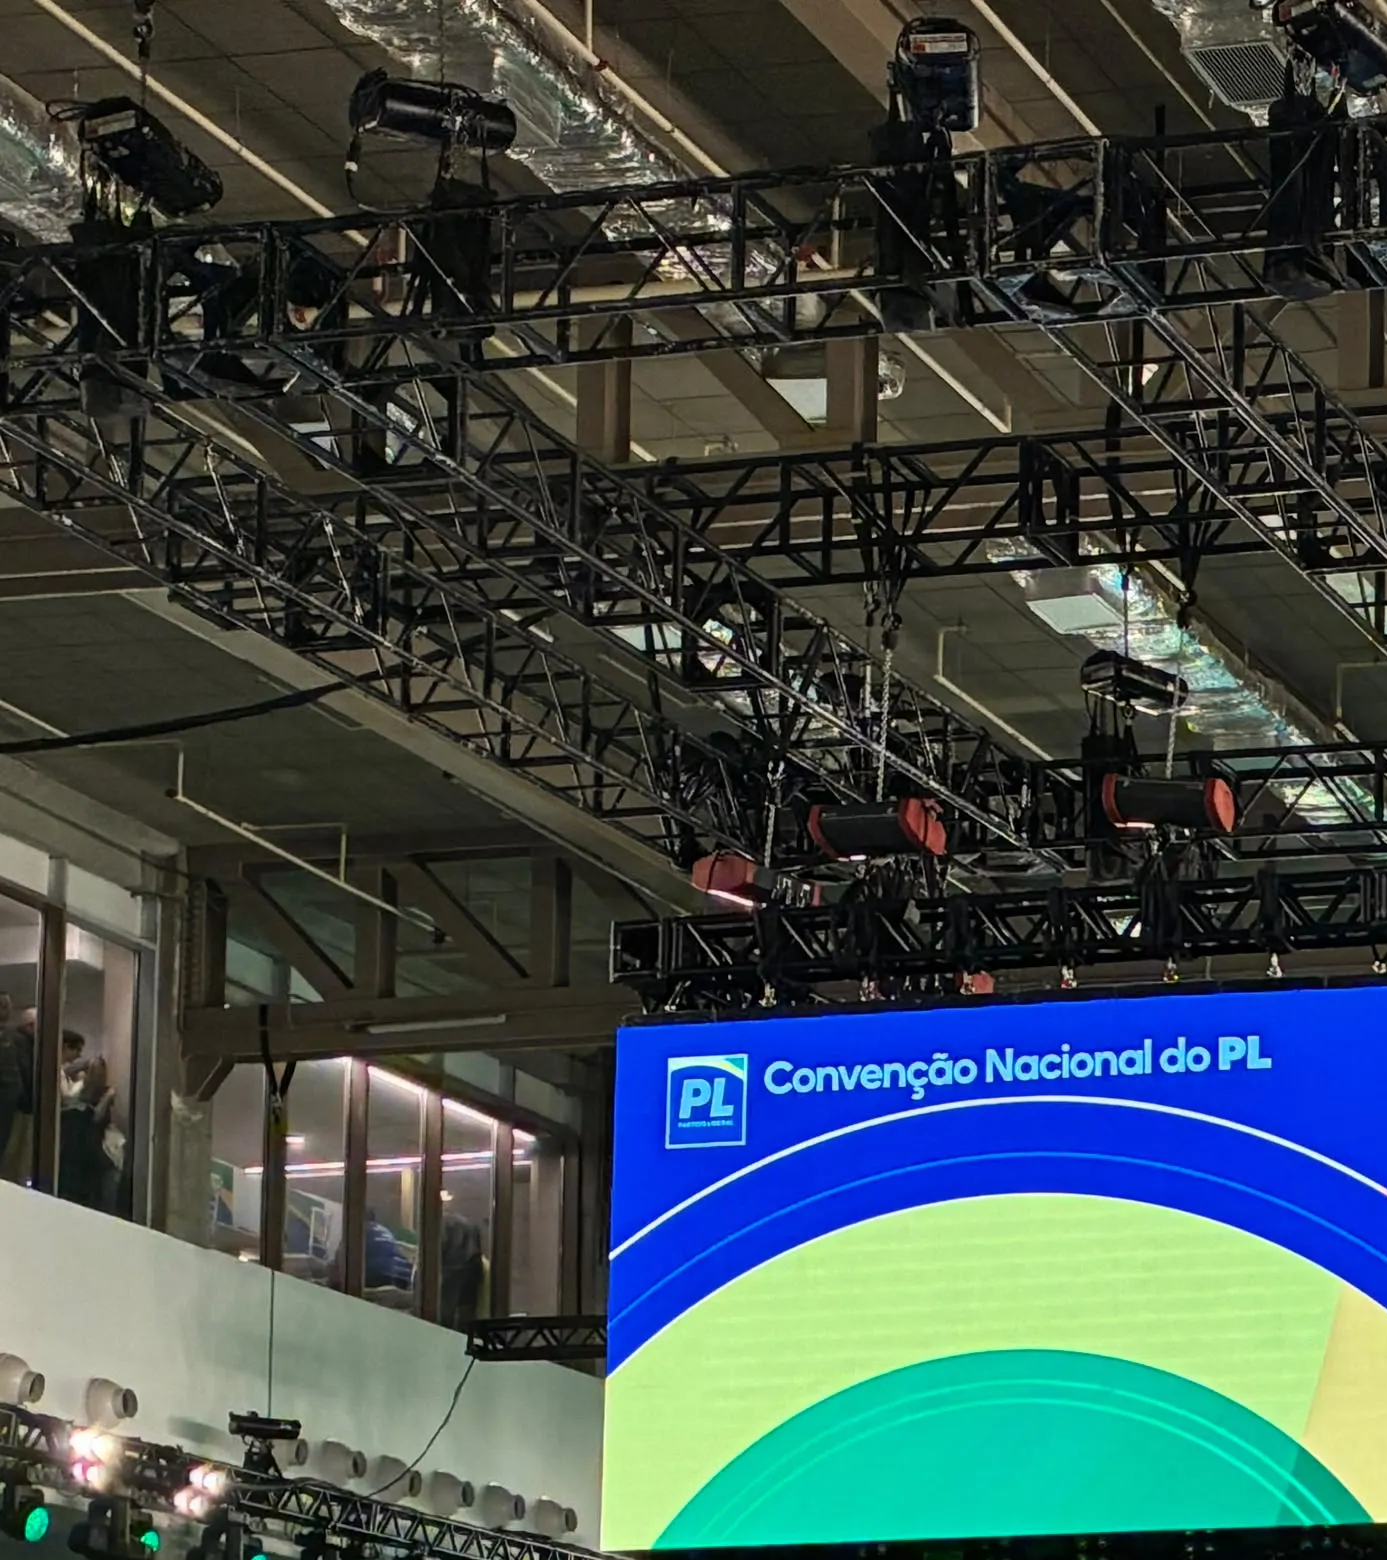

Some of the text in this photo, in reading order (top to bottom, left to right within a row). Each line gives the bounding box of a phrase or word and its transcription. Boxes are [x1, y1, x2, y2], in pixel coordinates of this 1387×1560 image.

[764, 1035, 1272, 1099] Convenção Nacional do PL
[679, 1077, 734, 1119] PL
